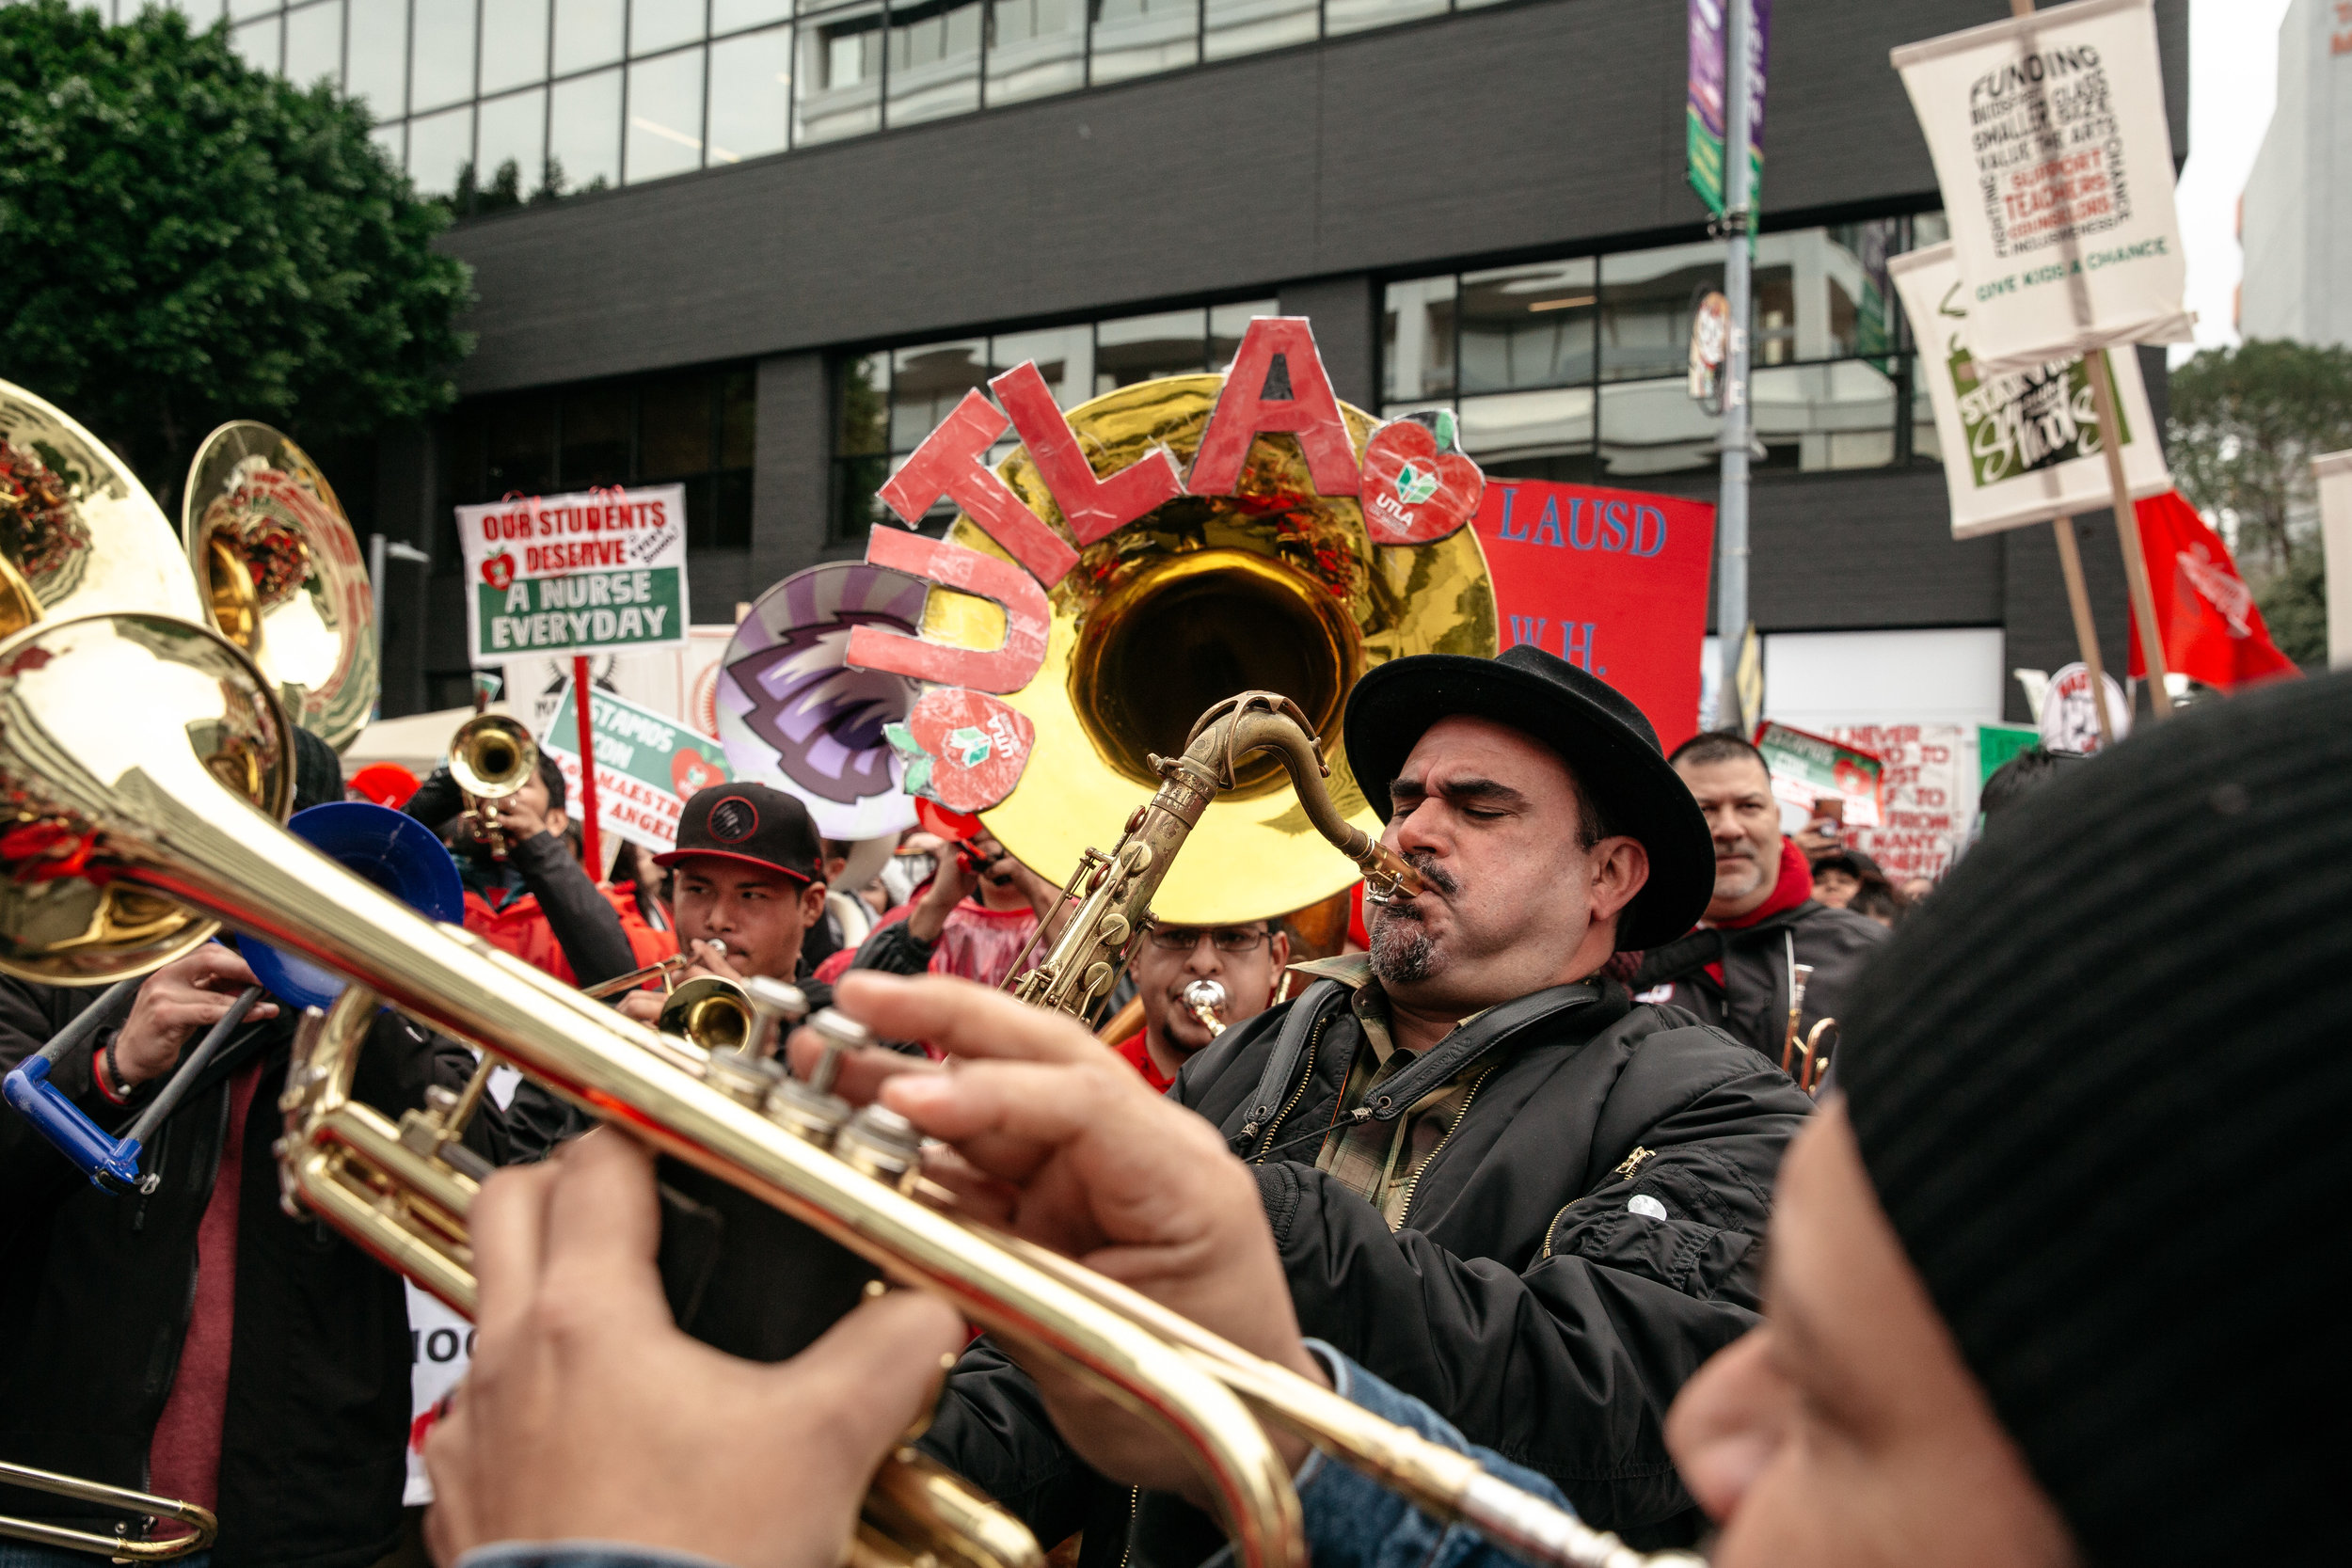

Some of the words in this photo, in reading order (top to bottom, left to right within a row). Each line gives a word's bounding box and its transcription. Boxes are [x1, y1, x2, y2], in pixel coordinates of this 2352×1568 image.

[1970, 44, 2101, 102] FUNDING
[2003, 173, 2108, 221] TEACHERS
[1976, 273, 2018, 302] GIVE
[2085, 235, 2169, 271] CHANCE
[483, 515, 533, 542] OUR
[539, 500, 667, 535] STUDENTS
[1375, 491, 1415, 528] UTLA
[1500, 486, 1667, 558] LAUSD
[526, 539, 627, 574] DESERVE
[504, 580, 532, 614] A
[540, 569, 652, 611] NURSE
[491, 604, 668, 649] EVERYDAY
[570, 696, 676, 753] STAMOS
[986, 714, 1014, 759] UTLA
[1920, 745, 1949, 764] TO
[1915, 786, 1946, 807] TO
